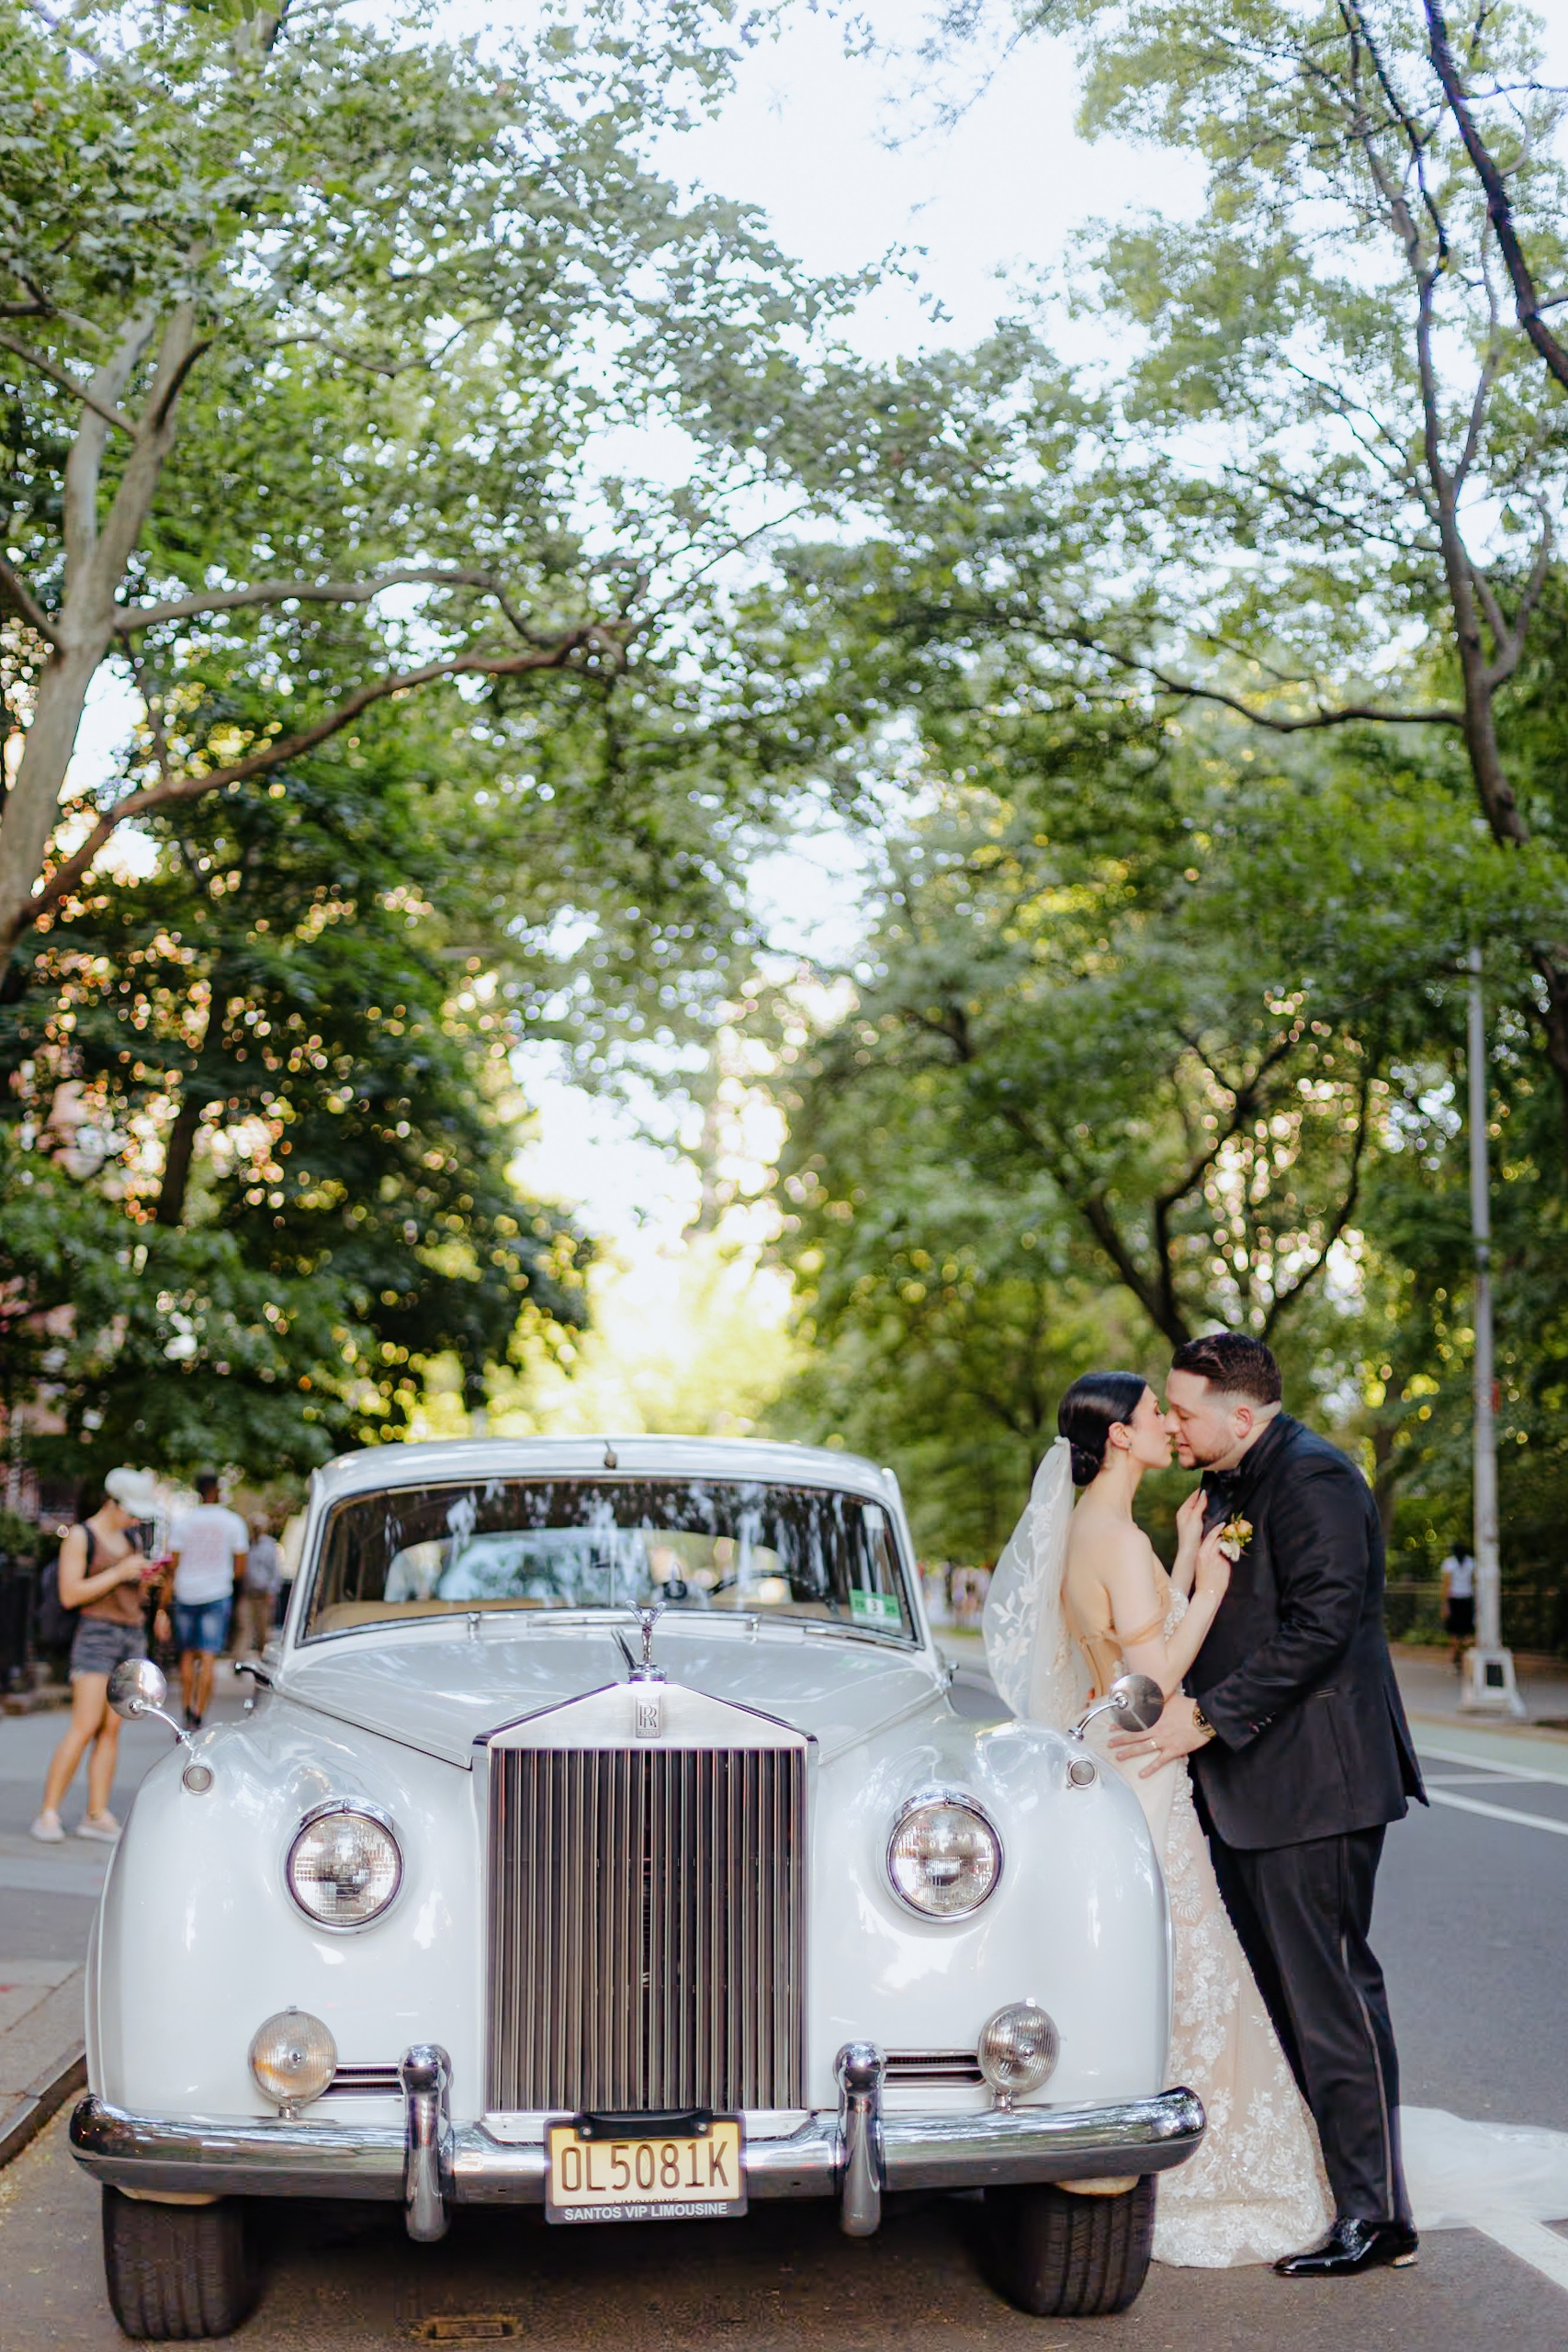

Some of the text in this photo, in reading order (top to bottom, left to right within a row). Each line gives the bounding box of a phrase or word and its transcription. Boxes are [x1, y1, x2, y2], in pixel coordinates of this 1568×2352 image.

[564, 2202, 728, 2222] SANTOS VIP LIMOUSINE
